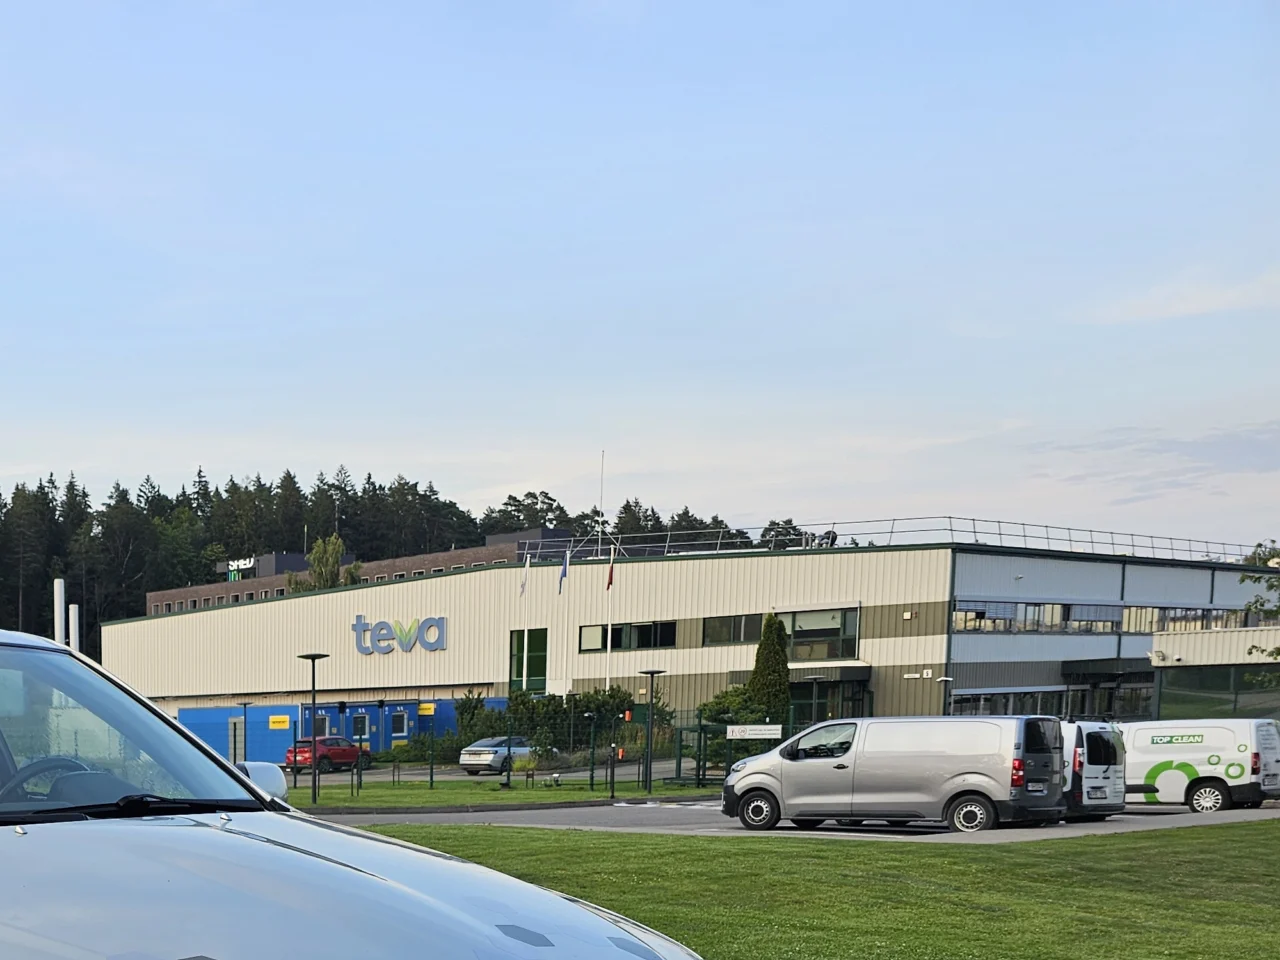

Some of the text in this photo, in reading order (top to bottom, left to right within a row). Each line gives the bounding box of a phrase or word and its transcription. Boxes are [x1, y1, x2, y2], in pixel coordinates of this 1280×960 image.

[351, 614, 447, 655] teva
[1152, 735, 1202, 744] TOP CLEAN
